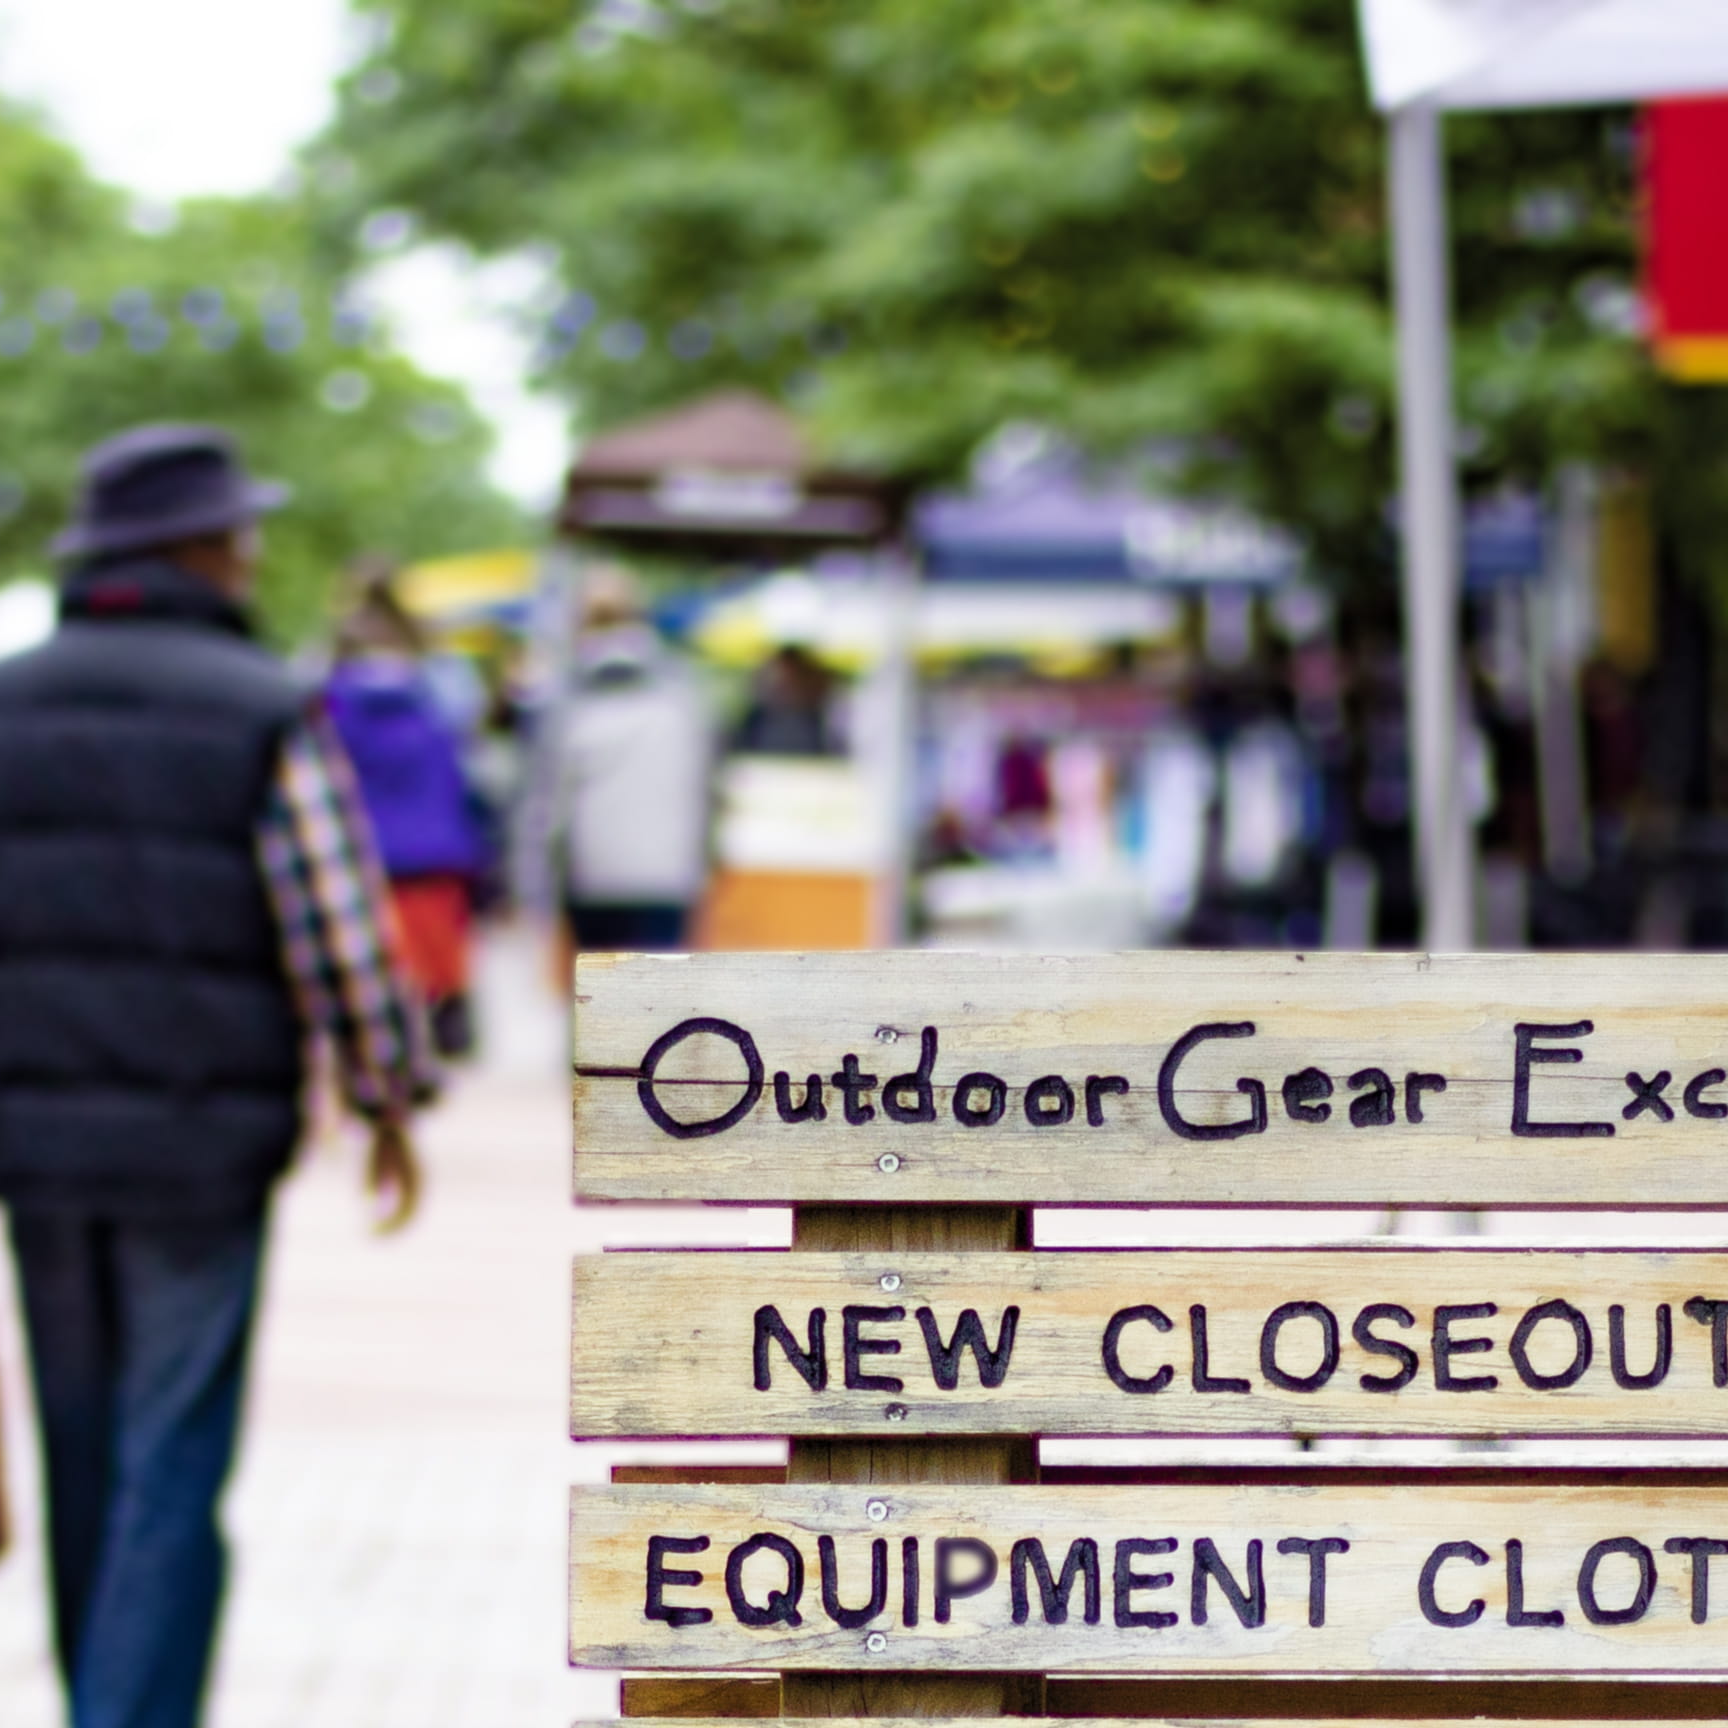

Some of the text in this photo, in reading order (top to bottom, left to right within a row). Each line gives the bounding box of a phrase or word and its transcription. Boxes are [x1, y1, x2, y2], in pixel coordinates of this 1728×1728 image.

[636, 1018, 1129, 1139] Outdoor
[1157, 1021, 1447, 1141] Gear
[753, 1305, 1020, 1393] NEW
[645, 1533, 1349, 1630] EQUIPMENT
